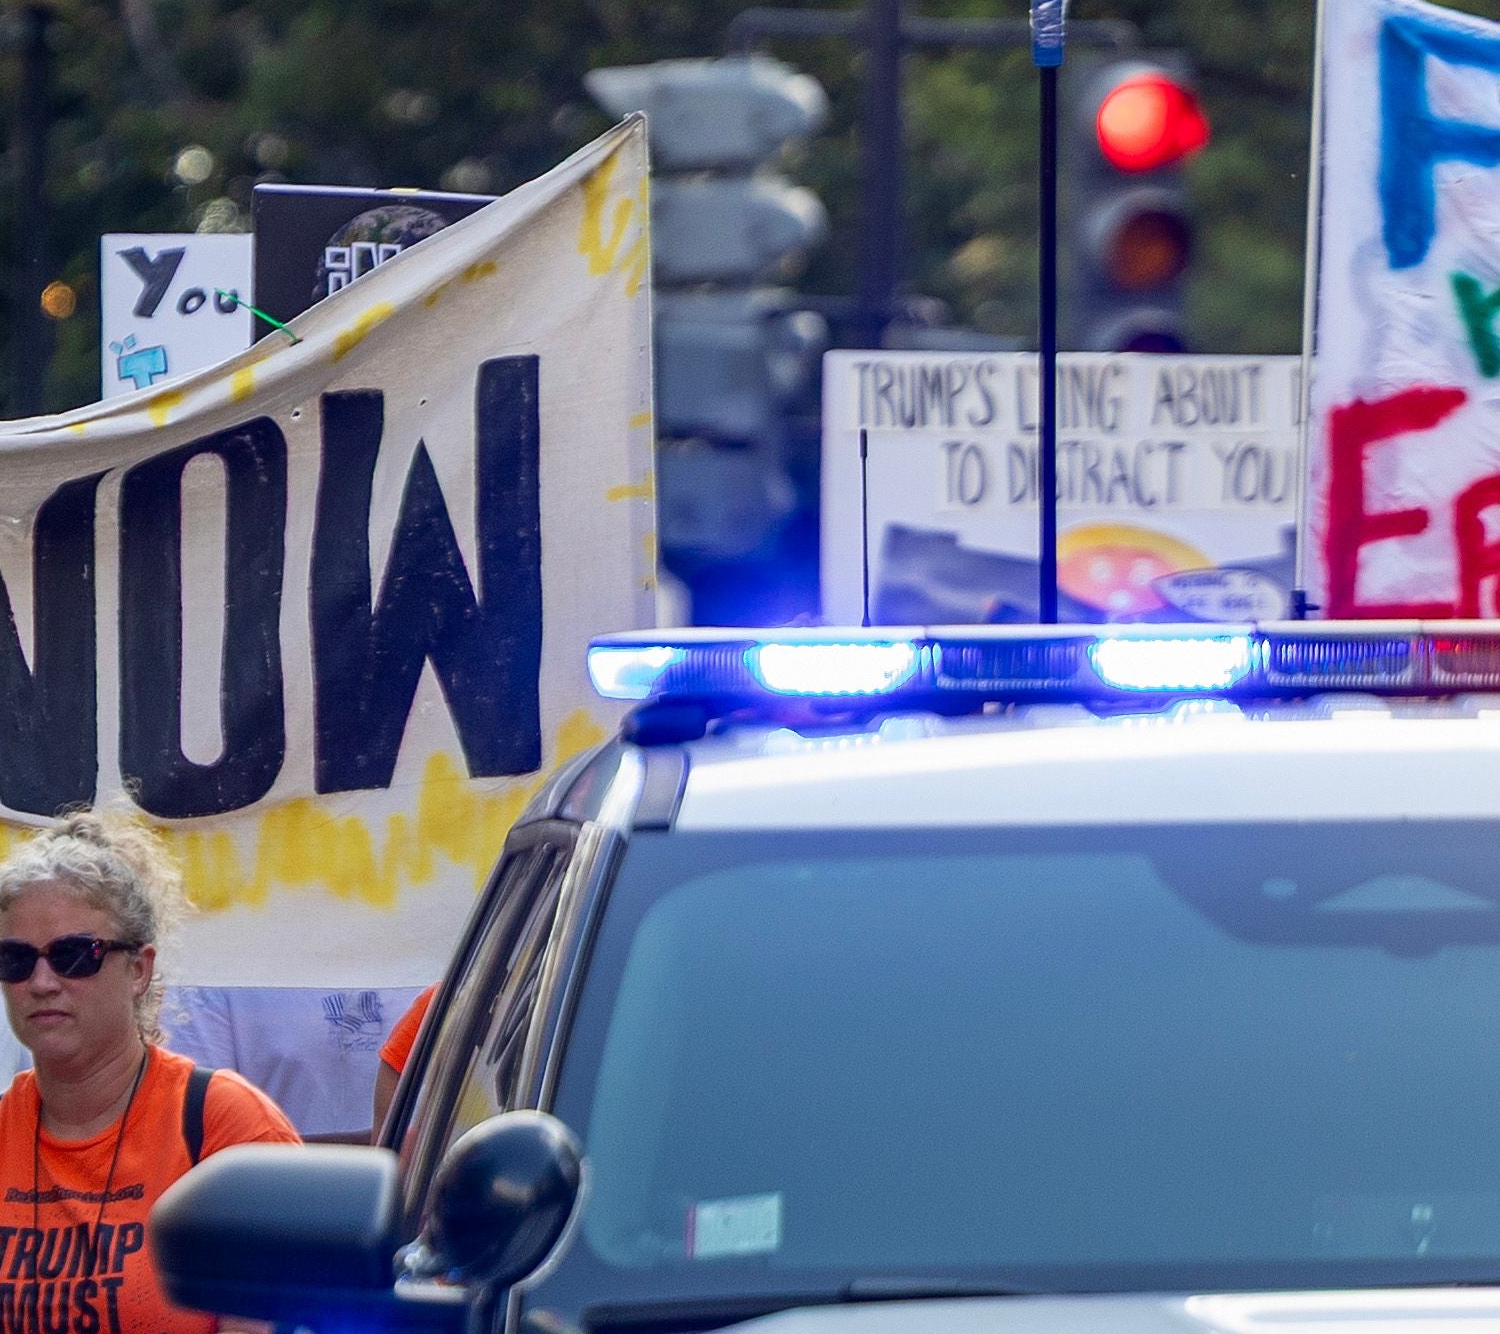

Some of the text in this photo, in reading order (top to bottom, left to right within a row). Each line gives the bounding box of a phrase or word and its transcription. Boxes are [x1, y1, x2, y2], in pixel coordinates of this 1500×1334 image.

[116, 246, 239, 318] You
[1016, 361, 1124, 432] LING
[1150, 361, 1264, 429] ABOUT
[942, 440, 987, 505] TO
[1008, 439, 1186, 507] DITRACT
